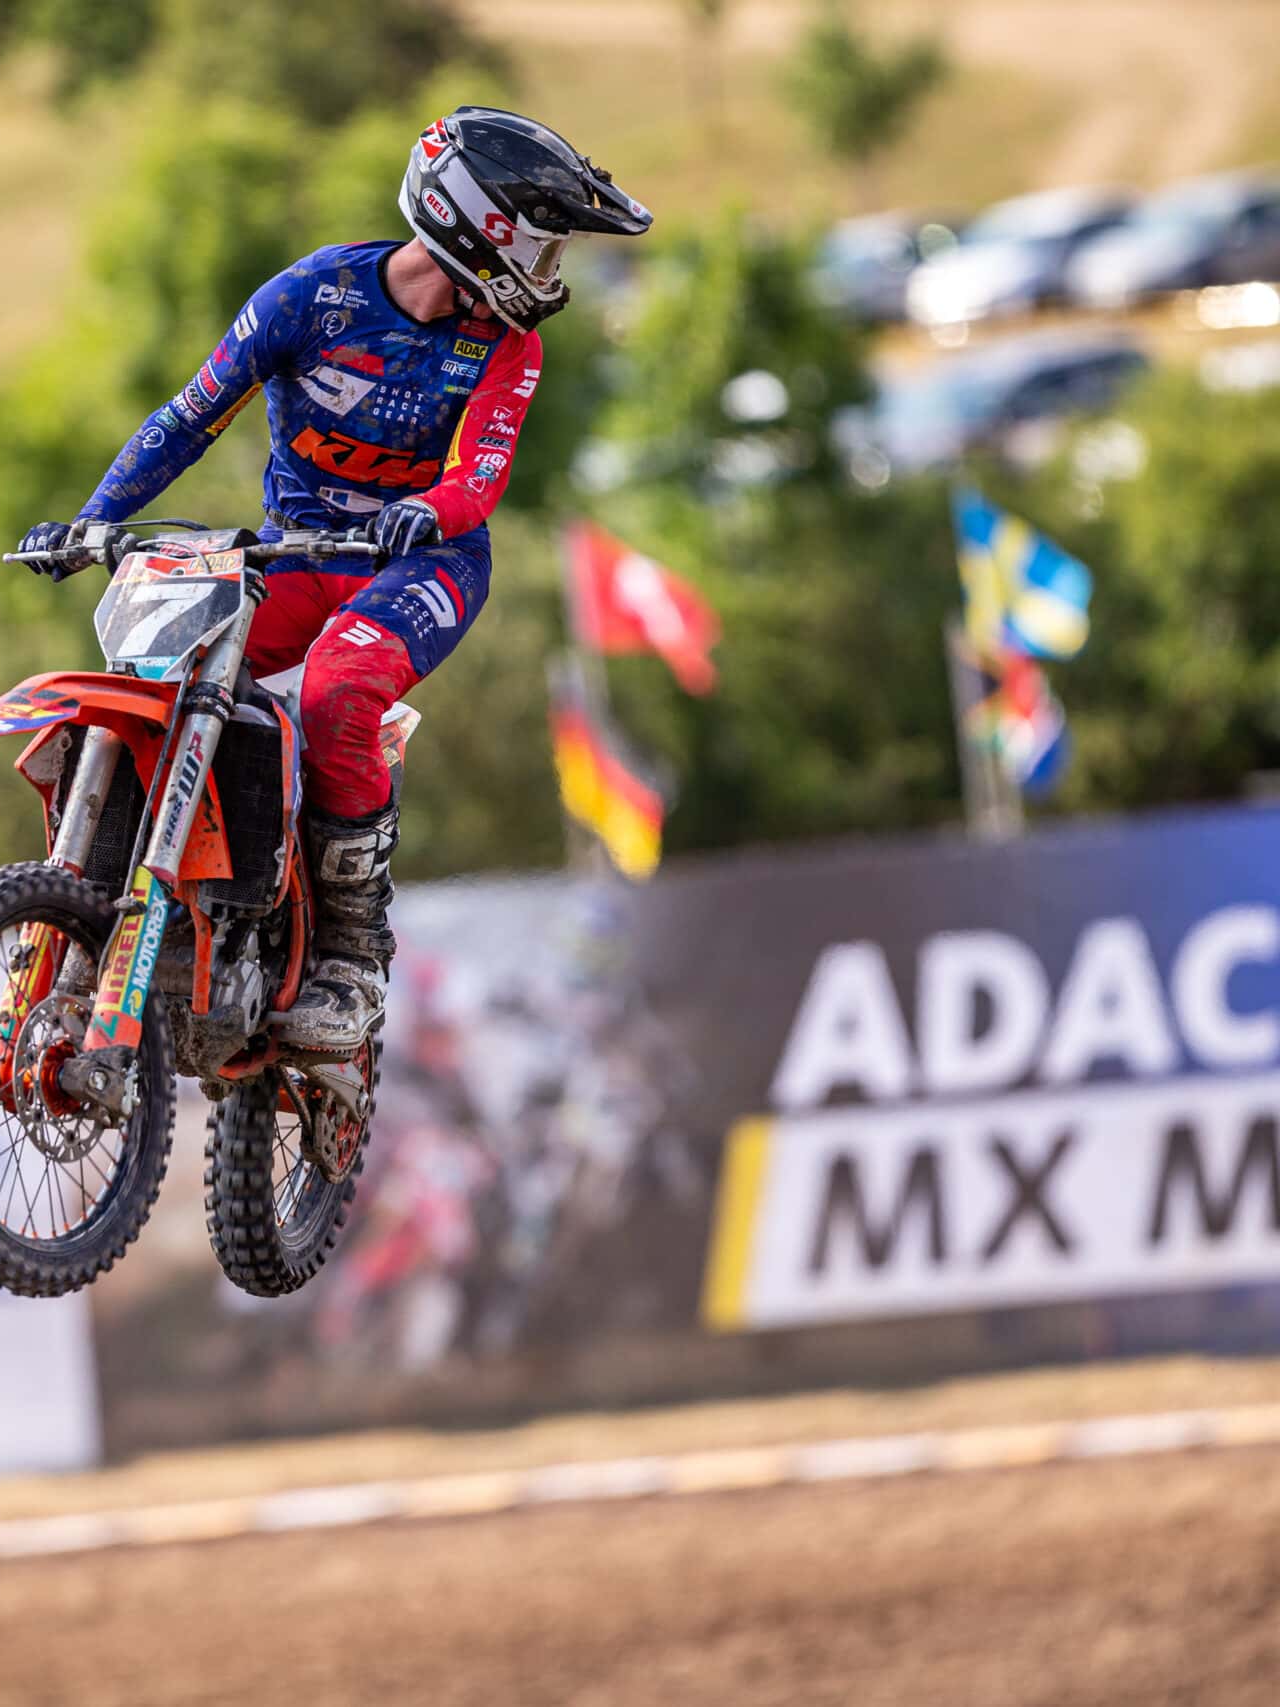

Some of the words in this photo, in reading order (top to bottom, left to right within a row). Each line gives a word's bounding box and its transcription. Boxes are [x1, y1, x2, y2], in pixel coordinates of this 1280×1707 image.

[425, 193, 450, 222] BELL
[455, 341, 487, 358] ADAC
[373, 407, 418, 425] GEAR
[376, 396, 421, 414] RACE
[380, 385, 424, 402] SHOT
[289, 425, 441, 489] KTM
[116, 582, 218, 658] 7
[99, 887, 147, 1005] PIRELI
[131, 893, 168, 990] MOTOREX
[770, 904, 1280, 1108] ADAC
[808, 1123, 1080, 1276] MX
